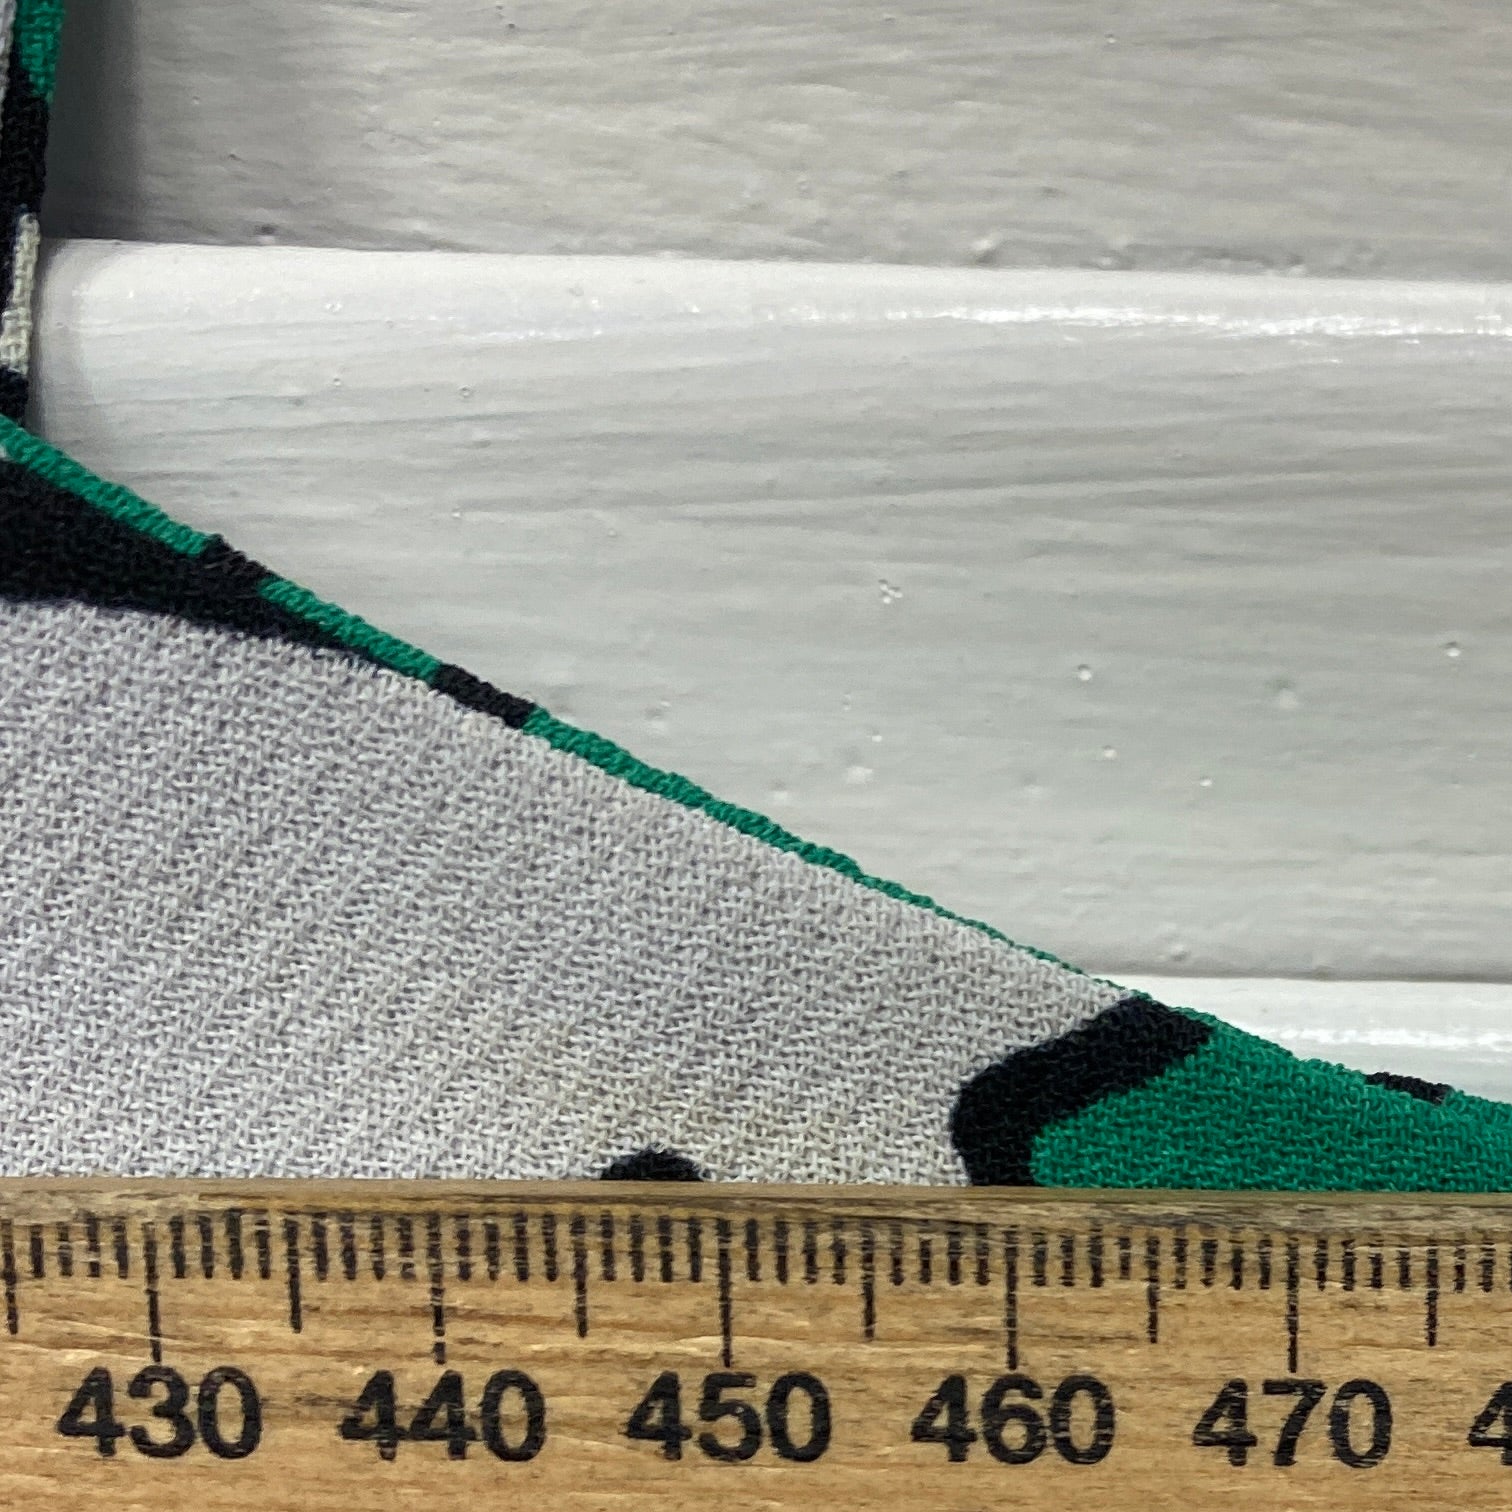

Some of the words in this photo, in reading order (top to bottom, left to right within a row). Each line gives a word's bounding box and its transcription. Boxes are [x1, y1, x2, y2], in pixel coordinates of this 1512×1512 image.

[57, 1365, 263, 1459] 430
[338, 1369, 547, 1462] 440
[624, 1370, 832, 1463] 450
[910, 1373, 1115, 1465] 460
[1192, 1378, 1393, 1469] 470
